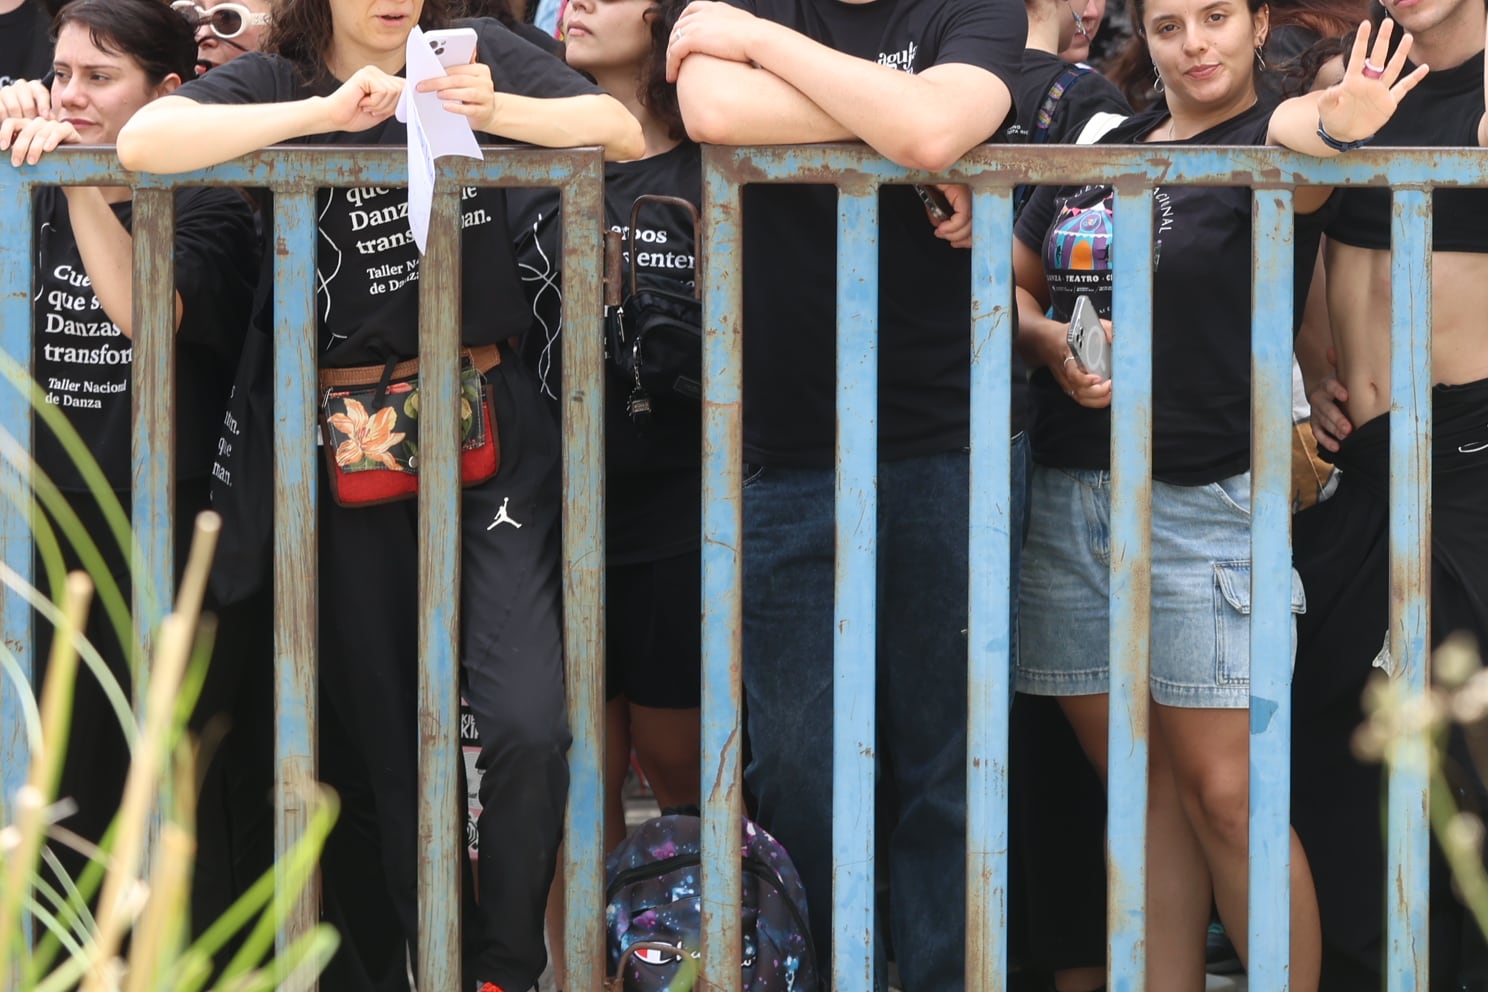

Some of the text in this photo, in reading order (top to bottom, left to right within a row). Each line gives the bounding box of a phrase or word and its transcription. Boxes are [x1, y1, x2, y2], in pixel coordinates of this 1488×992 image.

[366, 262, 404, 280] Taller
[1065, 274, 1100, 283] TEATRO
[369, 282, 386, 296] de
[48, 290, 87, 312] que
[48, 378, 81, 392] Taller
[45, 393, 103, 409] de Danza
